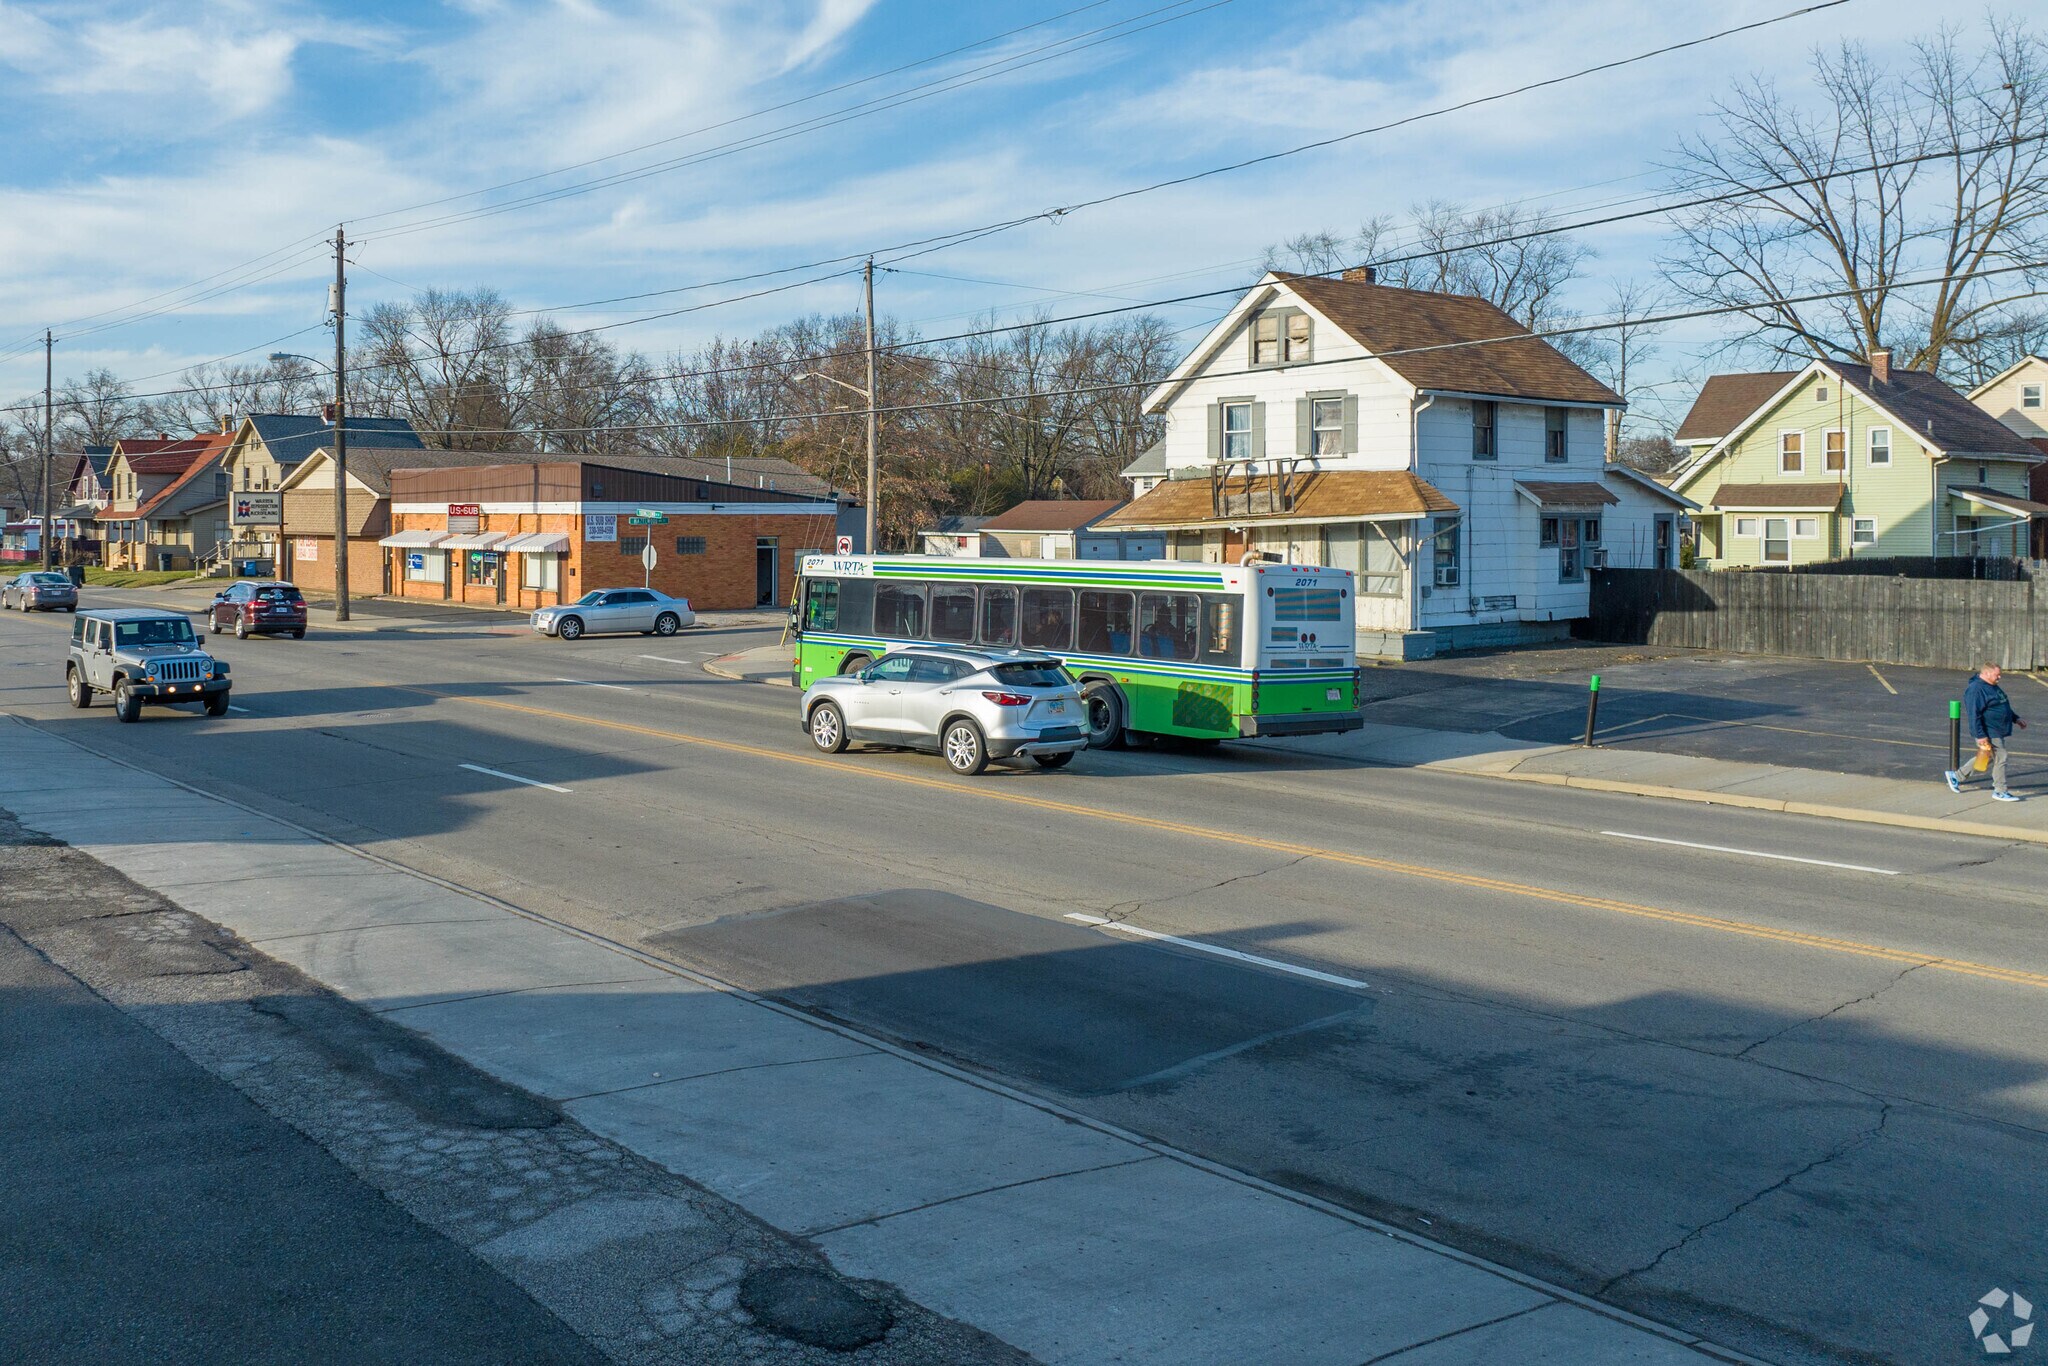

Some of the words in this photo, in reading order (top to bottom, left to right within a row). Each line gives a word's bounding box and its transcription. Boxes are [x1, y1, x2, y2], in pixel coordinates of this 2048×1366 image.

[463, 506, 478, 514] SUB
[596, 516, 604, 525] SUB
[605, 516, 616, 525] SHOP
[834, 561, 865, 572] WRTA
